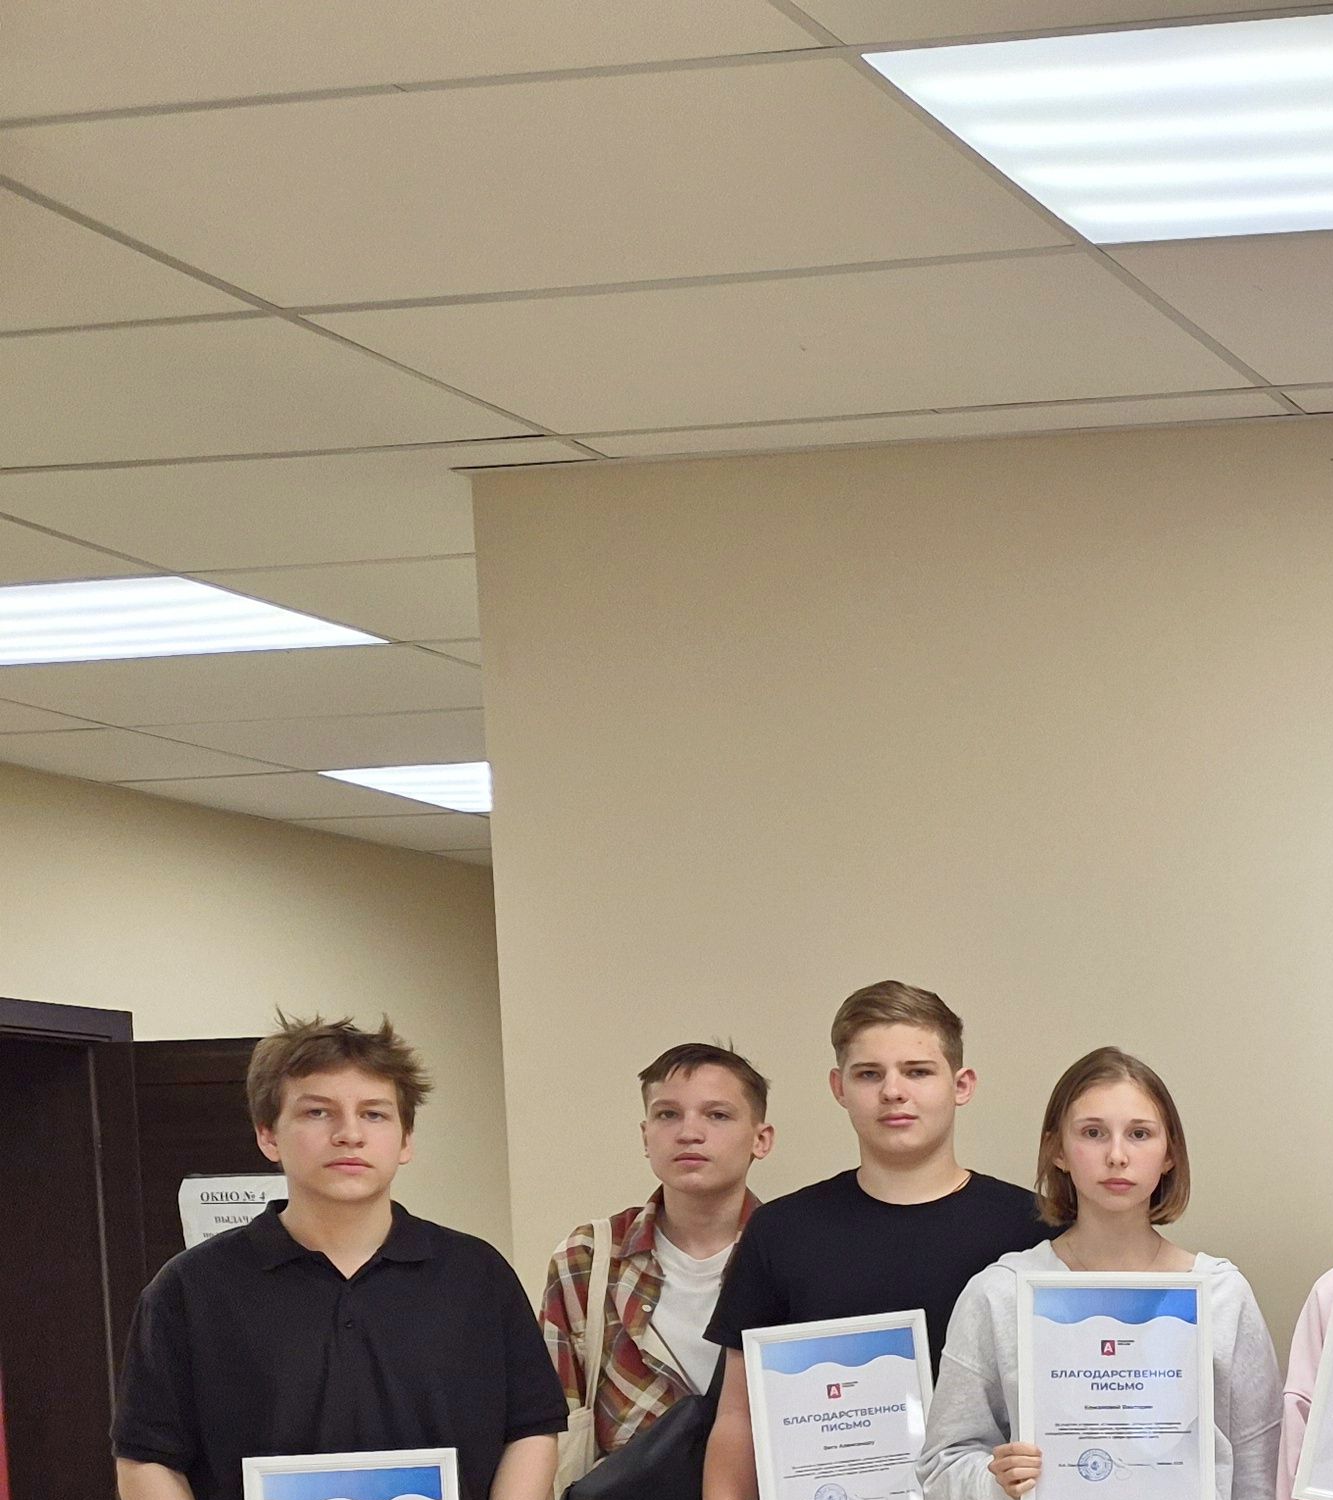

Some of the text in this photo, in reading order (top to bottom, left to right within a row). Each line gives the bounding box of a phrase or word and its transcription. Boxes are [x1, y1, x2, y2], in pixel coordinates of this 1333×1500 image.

[200, 1191, 239, 1202] ОКНО
[1050, 1369, 1183, 1381] БЛАГОДАРСТВЕННОЕ
[1090, 1382, 1144, 1391] ПИСЬМО
[783, 1403, 907, 1427] БЛАГОДАРСТВЕННОЕ
[821, 1419, 872, 1434] ПИСЬМО
